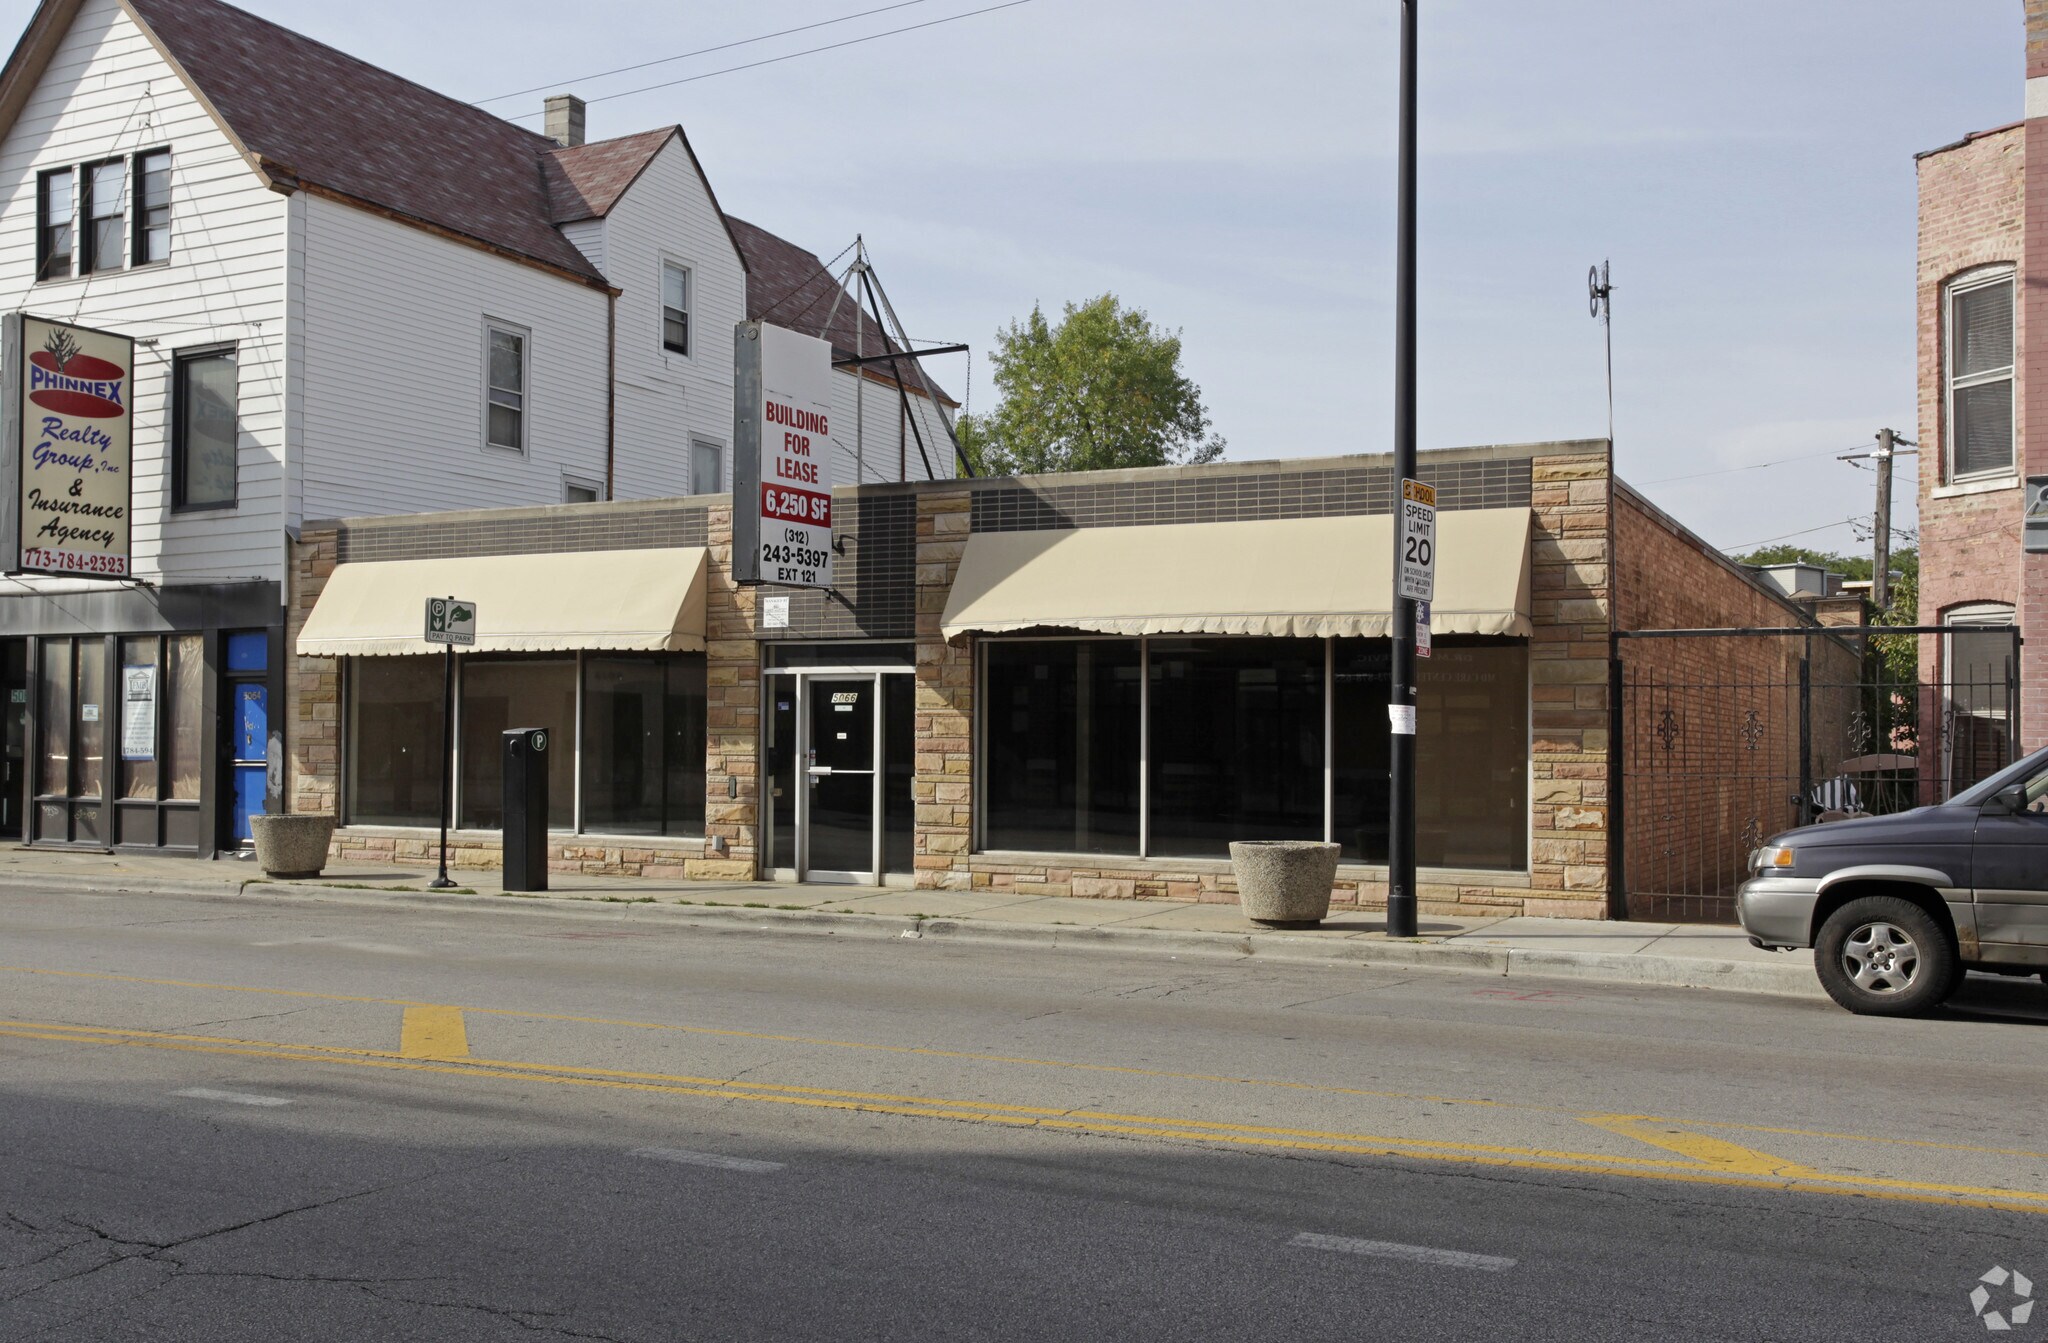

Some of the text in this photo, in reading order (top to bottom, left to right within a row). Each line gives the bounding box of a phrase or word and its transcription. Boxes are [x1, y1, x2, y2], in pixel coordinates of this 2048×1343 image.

[31, 364, 122, 404] PHINNEX
[766, 401, 828, 435] BUILDING
[41, 416, 112, 451] Realty
[784, 431, 810, 457] FOR
[776, 457, 818, 484] LEASE
[69, 478, 83, 497] &
[1405, 484, 1434, 503] SHOOL
[28, 488, 124, 519] Insurance
[766, 489, 828, 521] 6,250 SF
[1405, 504, 1433, 523] SPEED
[37, 516, 115, 548] Agency
[784, 527, 809, 546] (312)
[1408, 520, 1430, 537] LIMIT
[25, 549, 125, 574] 773-784-2323
[763, 544, 828, 569] 243-5397
[1405, 536, 1431, 566] 20
[778, 567, 816, 583] EXT 121
[1404, 566, 1431, 579] ON SCHOOL DAYS
[1414, 586, 1428, 595] PRESENT
[432, 632, 472, 643] PAY TO PARK
[833, 694, 856, 702] 5066
